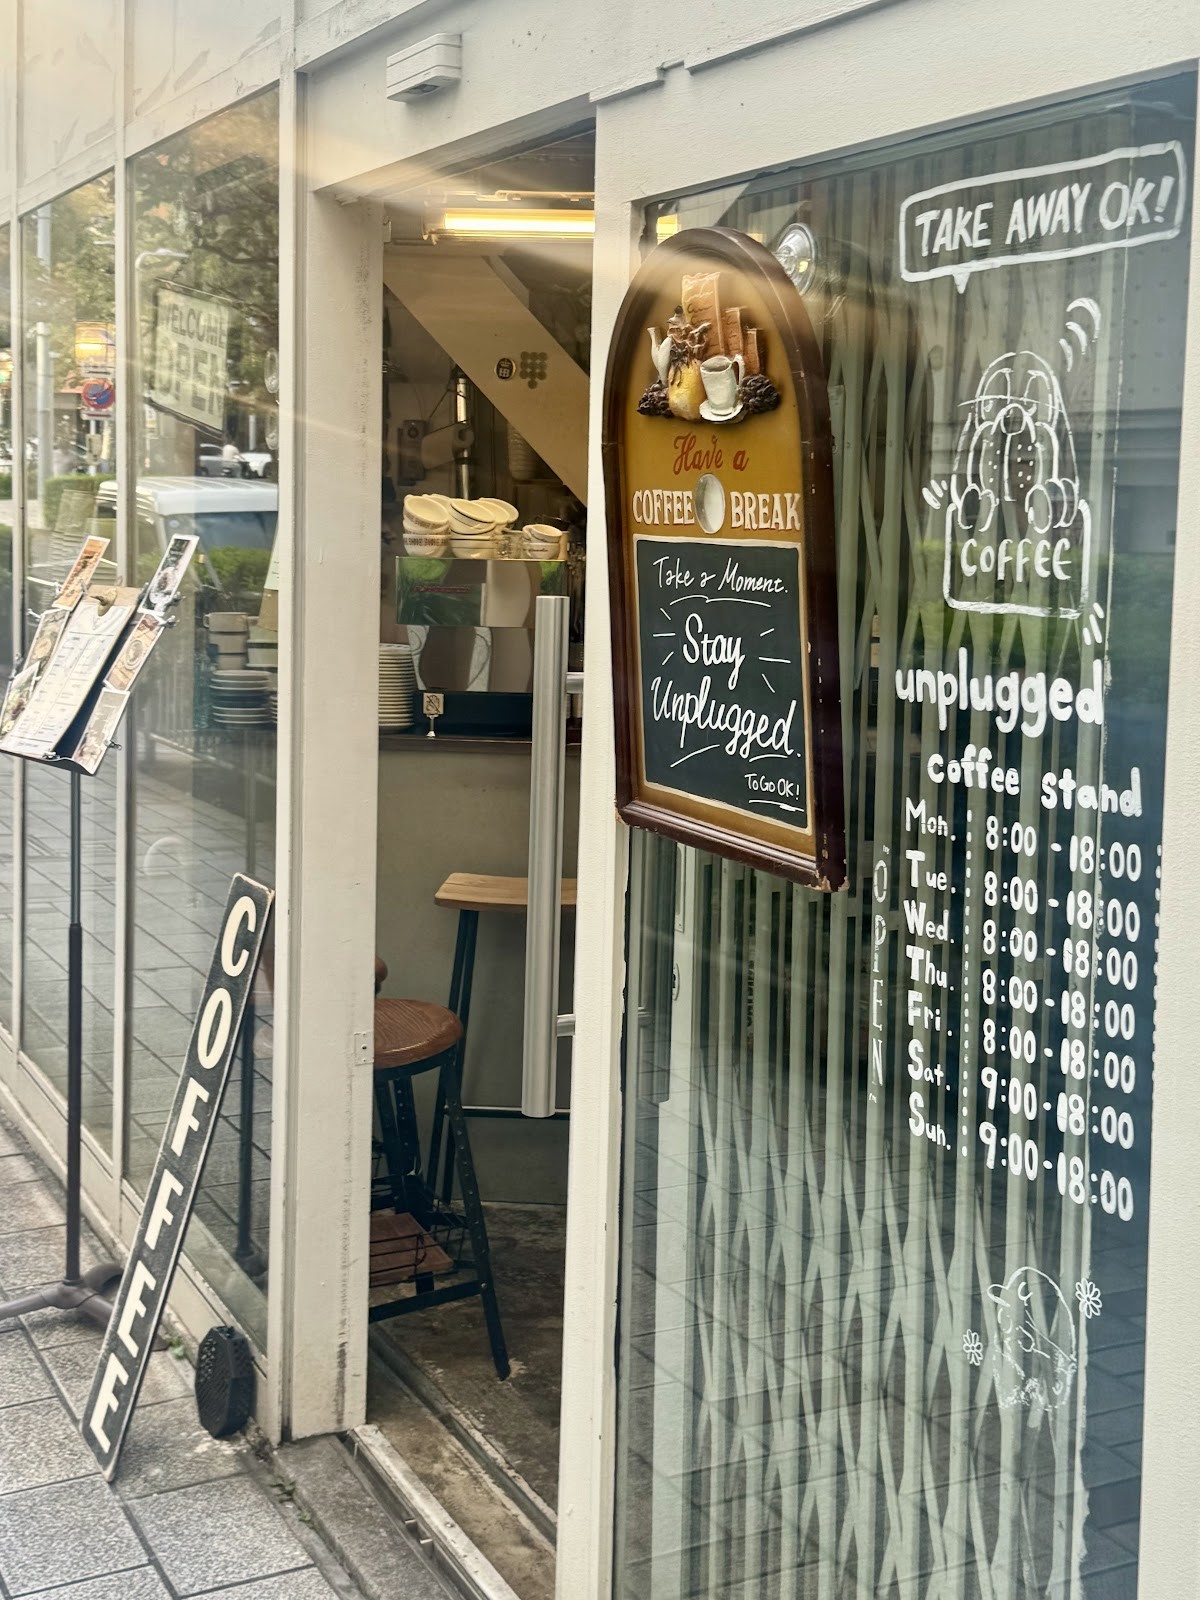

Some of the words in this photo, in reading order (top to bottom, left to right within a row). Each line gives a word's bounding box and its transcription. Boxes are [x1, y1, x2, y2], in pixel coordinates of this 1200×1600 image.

[915, 201, 994, 257] TAKE
[1005, 182, 1092, 245] AWAY
[1100, 175, 1175, 231] OK!
[672, 432, 723, 476] Have
[732, 449, 750, 471] a
[632, 488, 695, 525] COFFEE
[730, 491, 801, 531] BREAK
[653, 556, 694, 589] Take
[700, 571, 717, 588] a
[718, 557, 788, 593] Moment.
[960, 538, 1072, 583] COFFEE
[682, 613, 746, 691] Stay
[895, 647, 1105, 738] unplugged
[650, 675, 802, 760] Unplugged.
[927, 744, 1020, 796] coffee
[1041, 767, 1142, 817] stand
[905, 797, 956, 841] Mon.
[905, 849, 956, 894] Tue.
[903, 899, 955, 943] Wed.
[905, 944, 955, 991] Thu.
[907, 989, 953, 1036] Fri.
[908, 1038, 951, 1091] Sat.
[908, 1091, 951, 1151] Sun.
[89, 895, 256, 1454] COFFEE
